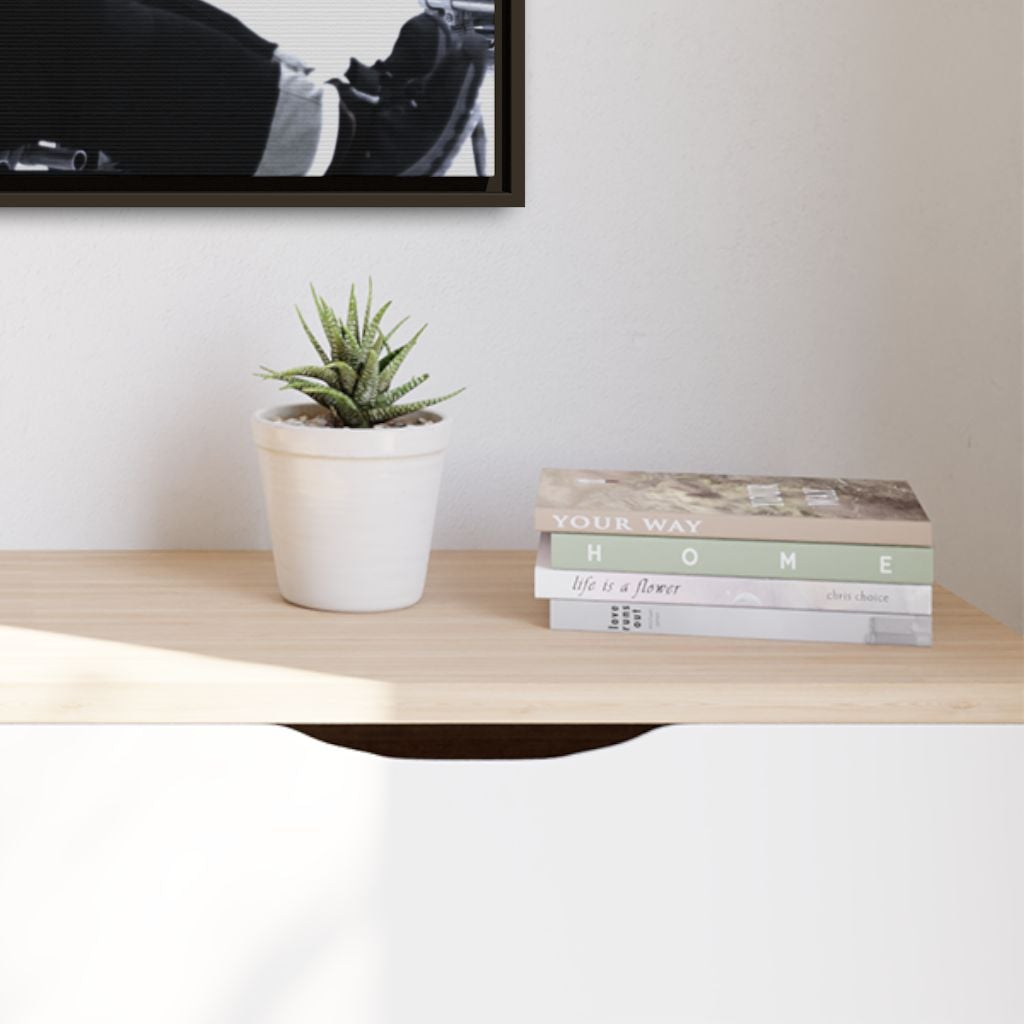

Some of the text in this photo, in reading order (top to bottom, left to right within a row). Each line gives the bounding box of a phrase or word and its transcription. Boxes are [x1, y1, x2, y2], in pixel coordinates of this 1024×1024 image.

[552, 514, 703, 533] YOUR WAY
[572, 576, 681, 599] life is a flower
[826, 589, 852, 602] chris
[607, 605, 619, 630] love
[621, 605, 631, 632] runs
[632, 609, 642, 629] out
